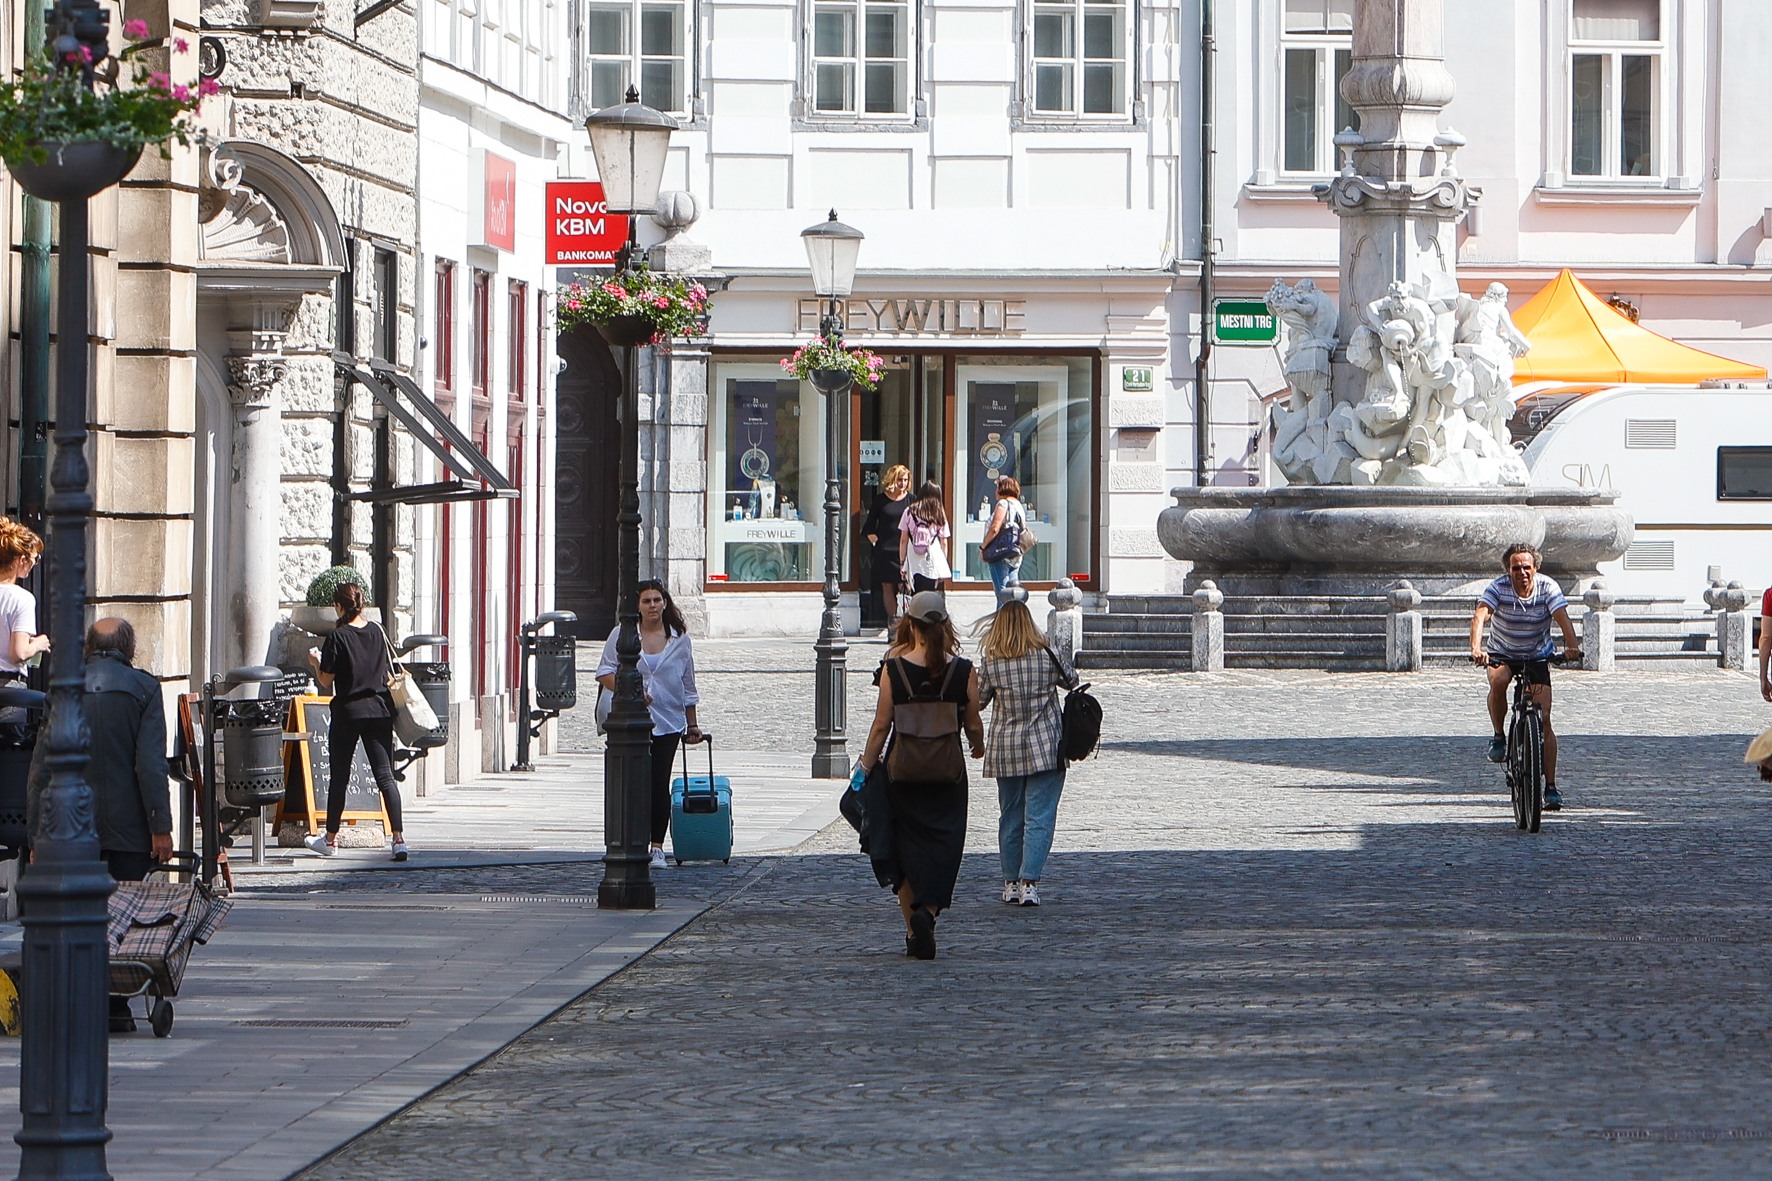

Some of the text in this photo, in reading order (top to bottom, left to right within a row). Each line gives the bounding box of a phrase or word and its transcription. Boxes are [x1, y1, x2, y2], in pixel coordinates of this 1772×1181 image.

[556, 218, 605, 236] KBM
[557, 250, 616, 261] BANKOMA
[794, 298, 1027, 332] FREYWILLE
[1220, 314, 1273, 329] MESTNI TRG
[1132, 370, 1145, 383] 21
[746, 529, 796, 539] FREYWILLE
